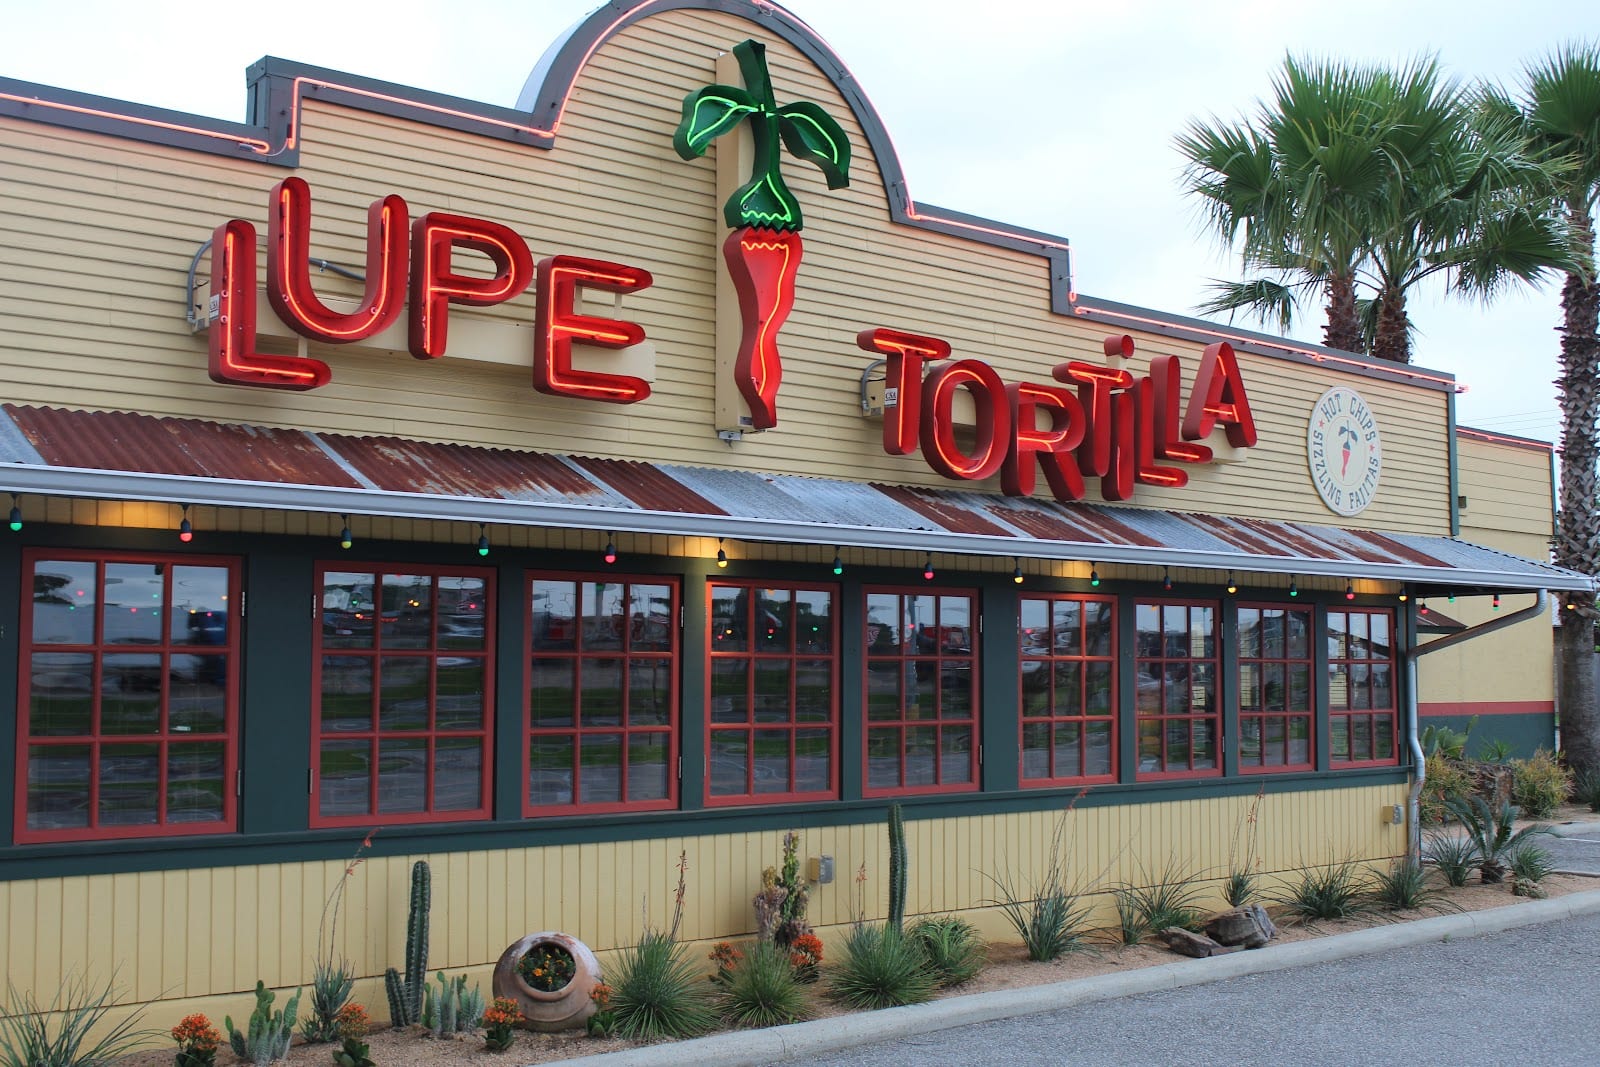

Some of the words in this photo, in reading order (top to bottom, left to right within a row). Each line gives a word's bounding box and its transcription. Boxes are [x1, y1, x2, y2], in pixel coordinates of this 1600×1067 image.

[208, 176, 653, 404] LUPE
[1321, 393, 1342, 422] HOT
[1349, 397, 1376, 442] CHIPS
[1313, 430, 1342, 506] SIZZLING
[1349, 456, 1379, 509] FAJITAS
